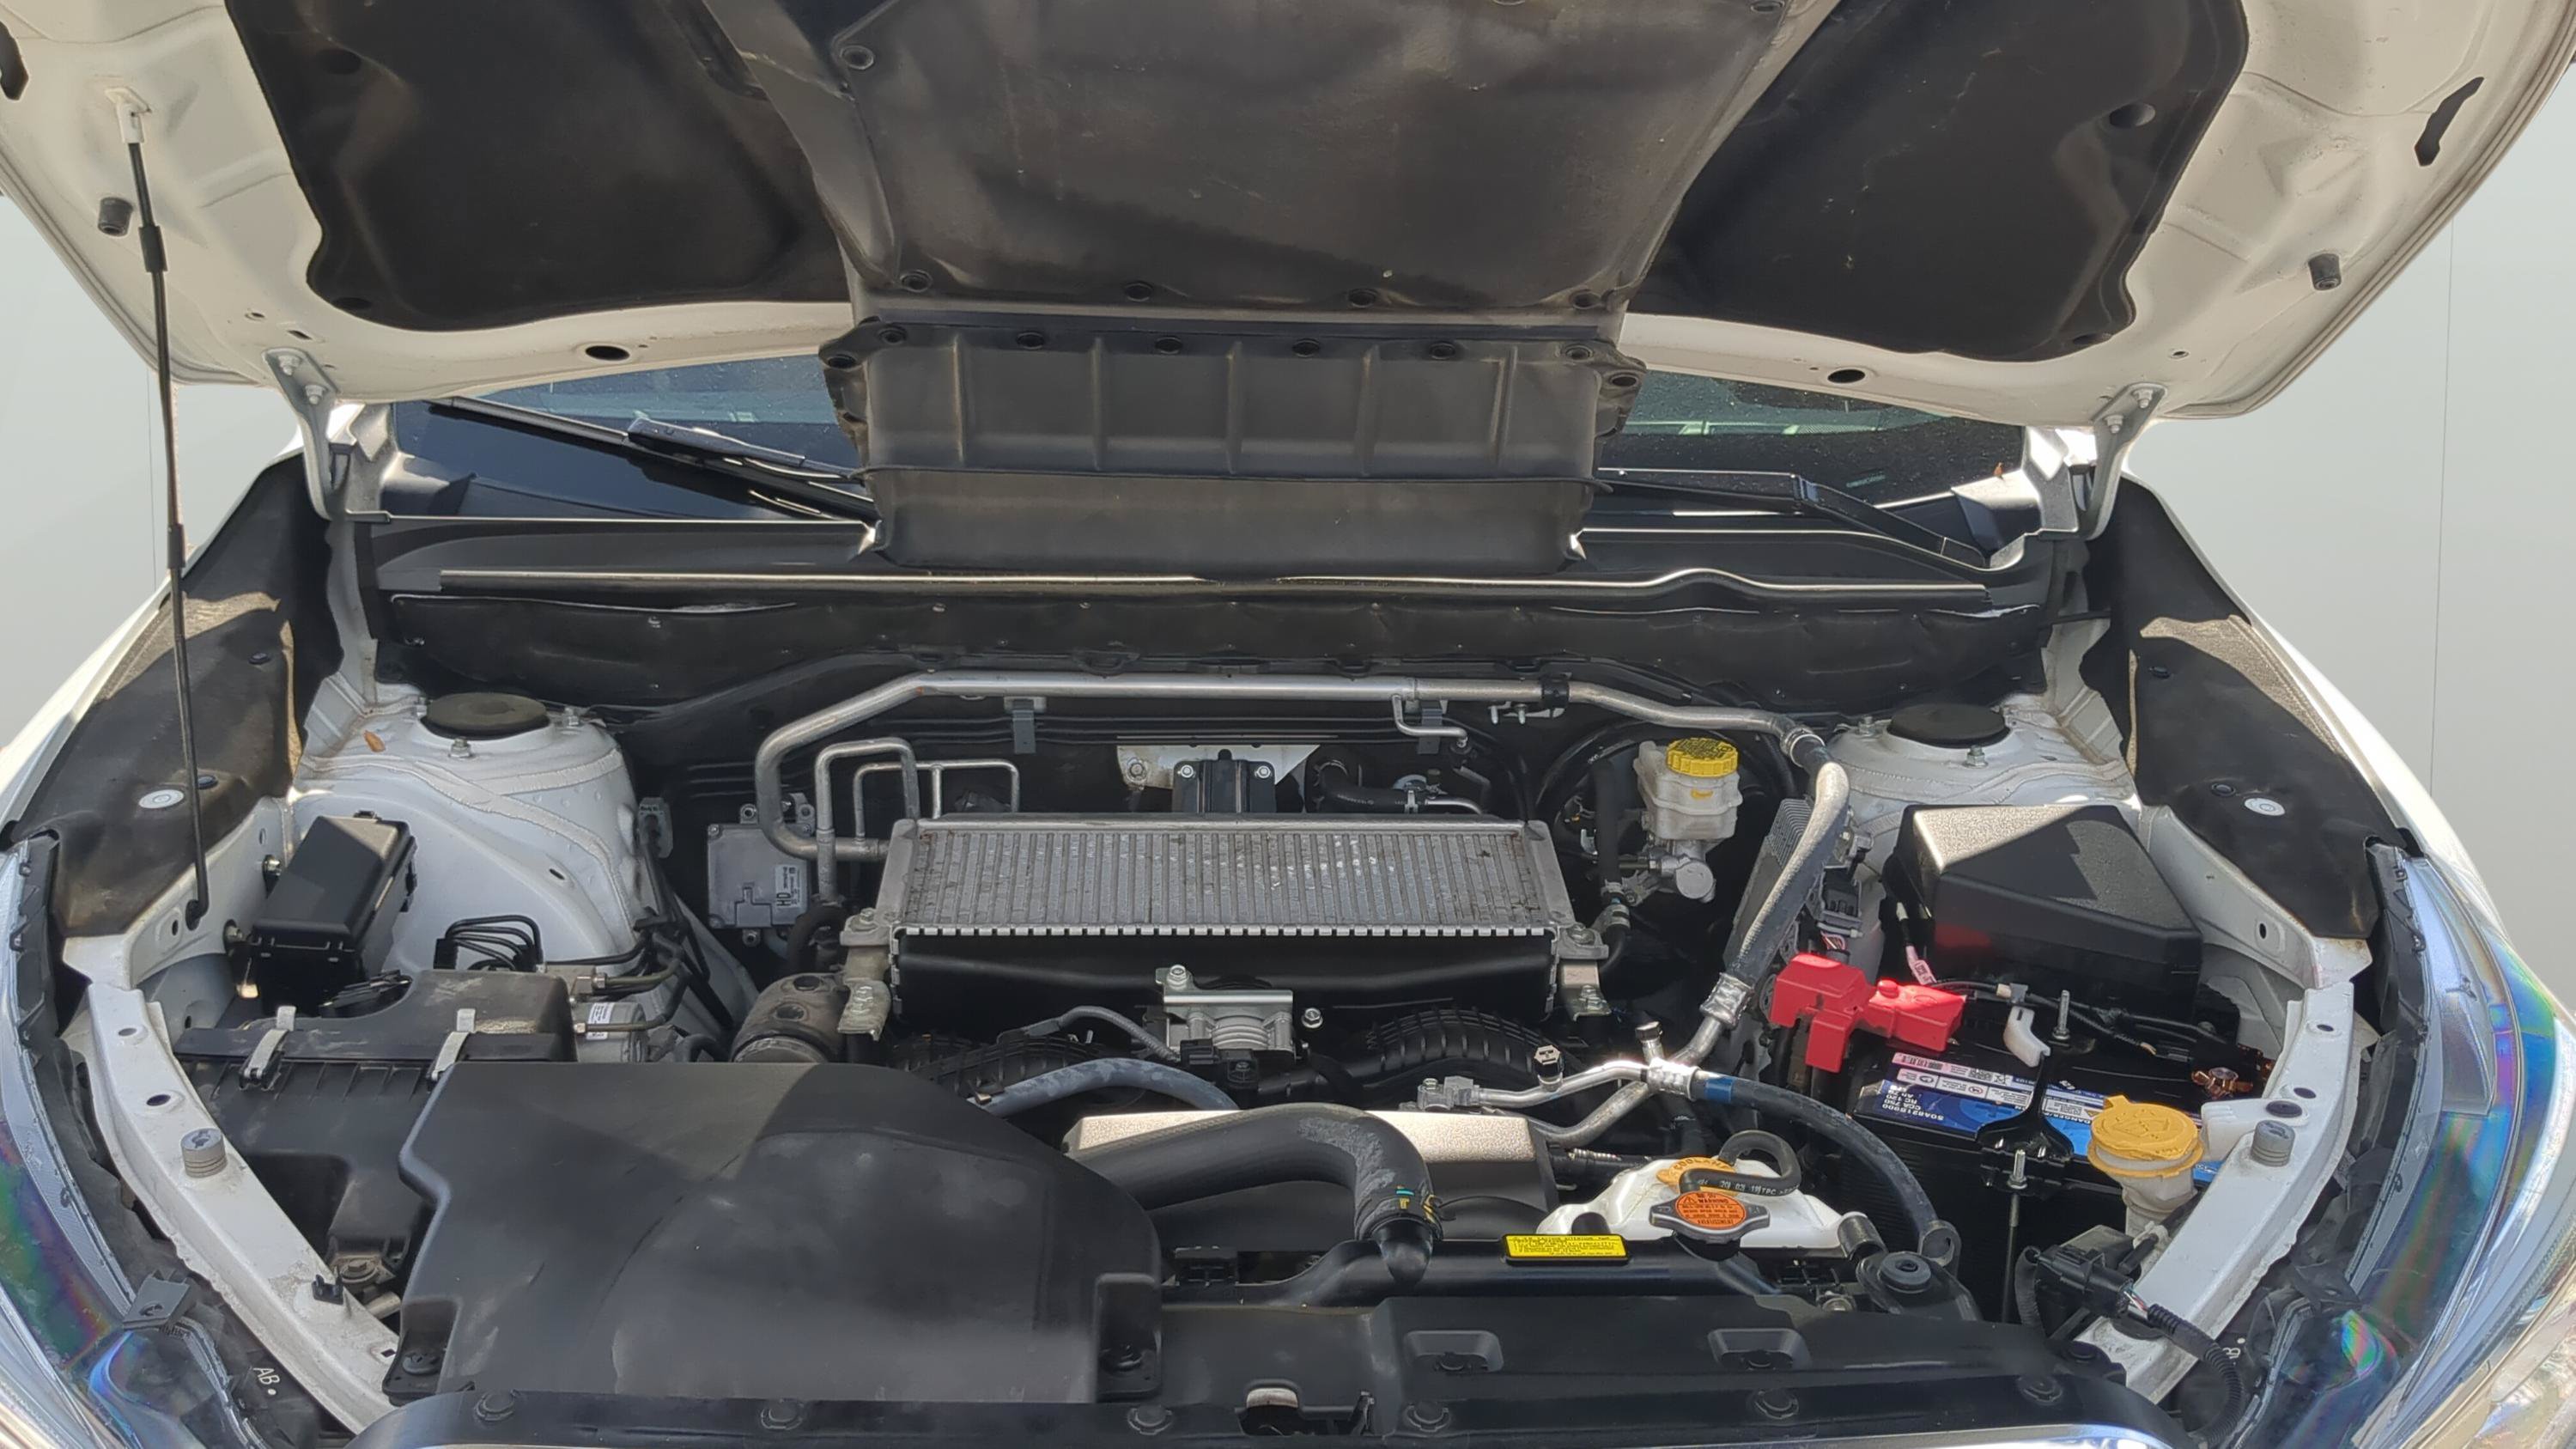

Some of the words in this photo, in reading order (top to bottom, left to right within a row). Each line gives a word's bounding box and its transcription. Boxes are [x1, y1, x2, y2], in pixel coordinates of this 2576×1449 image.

[776, 892, 792, 906] HD
[1903, 1102, 1921, 1111] CCA
[252, 1367, 281, 1385] AB
